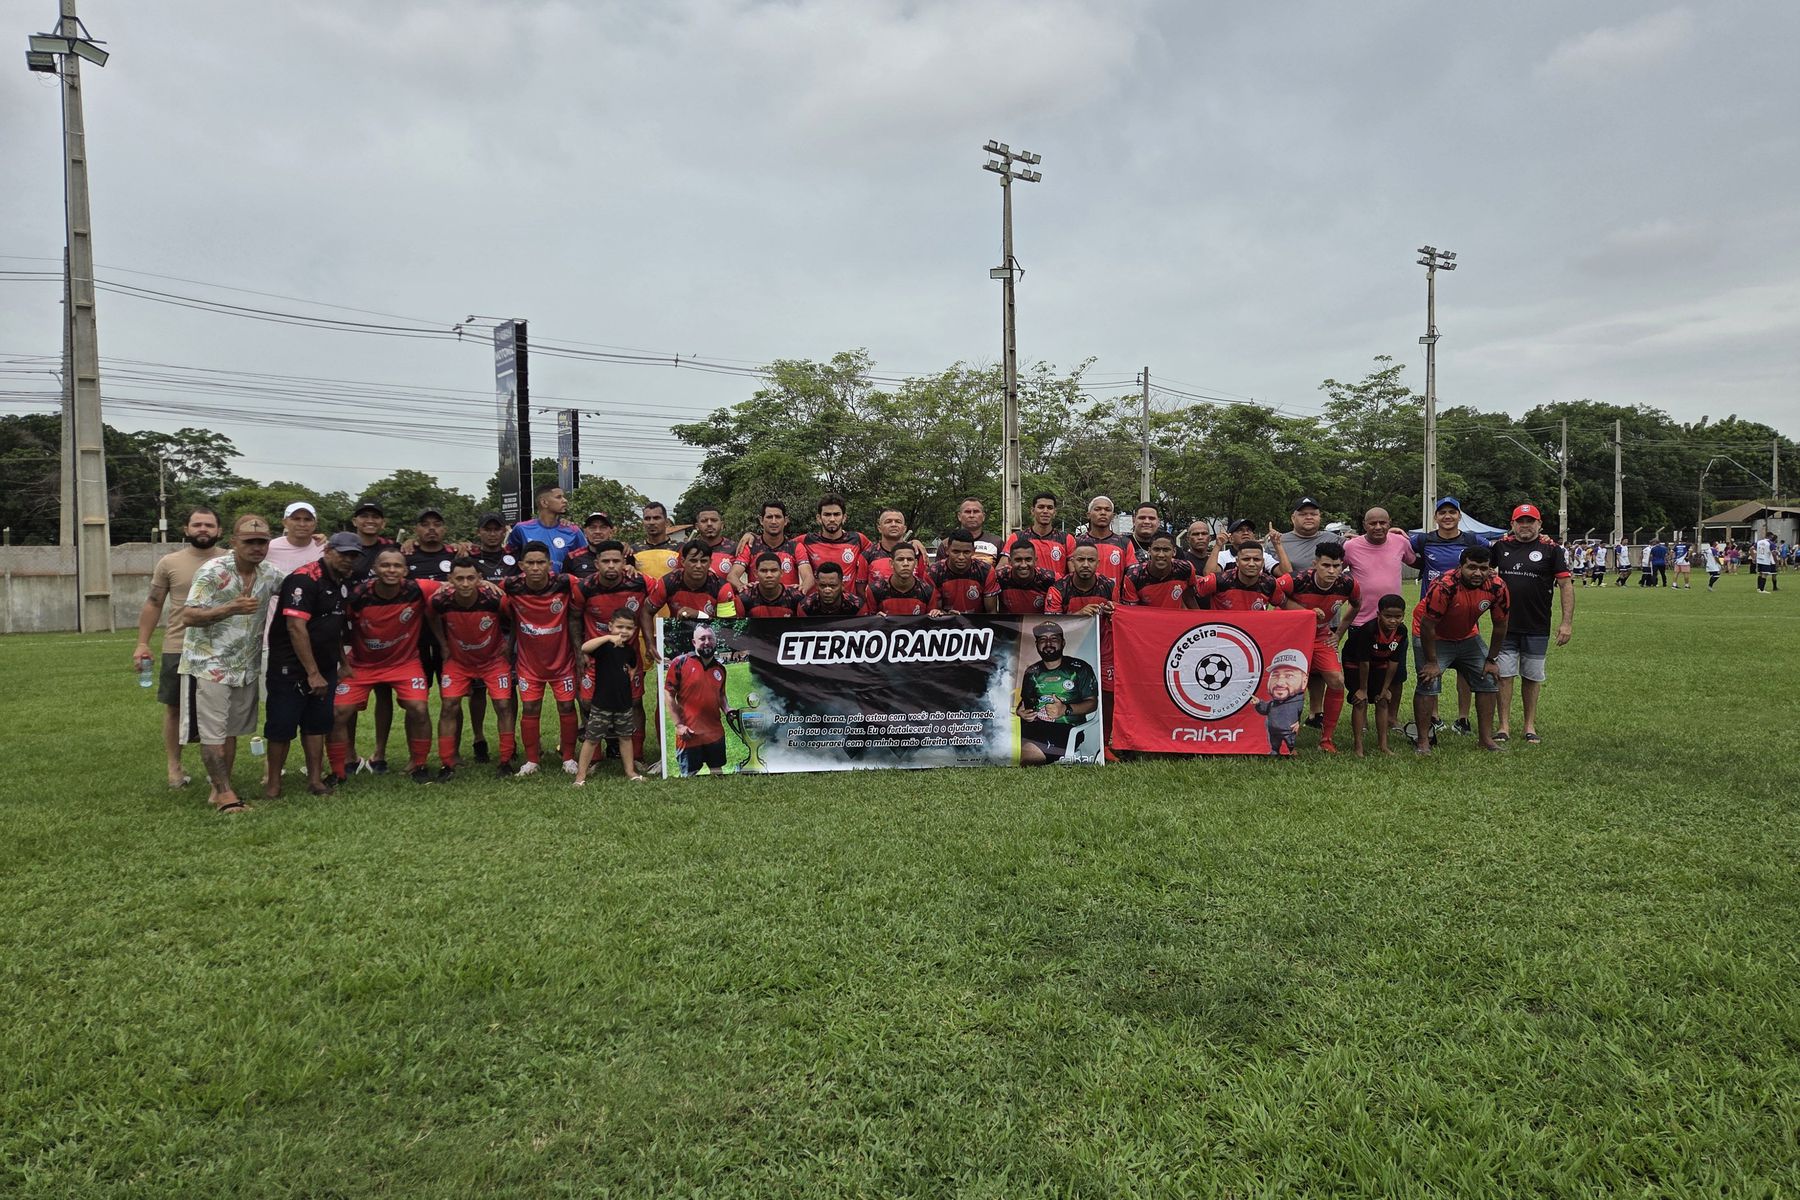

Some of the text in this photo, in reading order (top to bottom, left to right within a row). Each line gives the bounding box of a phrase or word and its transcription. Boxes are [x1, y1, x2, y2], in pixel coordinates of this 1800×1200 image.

[779, 631, 991, 662] ETERNO RANDIN
[1170, 628, 1217, 668] Cafeteira
[411, 678, 426, 689] 22
[563, 678, 574, 691] 15
[1211, 697, 1243, 714] Futebol
[774, 713, 788, 723] Por
[788, 714, 804, 723] isso
[805, 714, 821, 723] não
[847, 713, 864, 724] pois
[865, 712, 887, 722] estou
[888, 713, 906, 721] com
[929, 711, 946, 720] não
[946, 710, 970, 720] tenha
[787, 726, 804, 737] pois
[805, 727, 820, 735] sou
[828, 728, 843, 736] seu
[866, 726, 878, 735] Eu
[887, 724, 933, 734] fortalecerei
[1172, 726, 1244, 742] raikar
[788, 739, 799, 747] Eu
[807, 740, 845, 749] segurarei
[872, 738, 900, 746] minha
[900, 737, 919, 746] mão
[921, 736, 947, 746] direita
[948, 735, 983, 746] vitoriosa.
